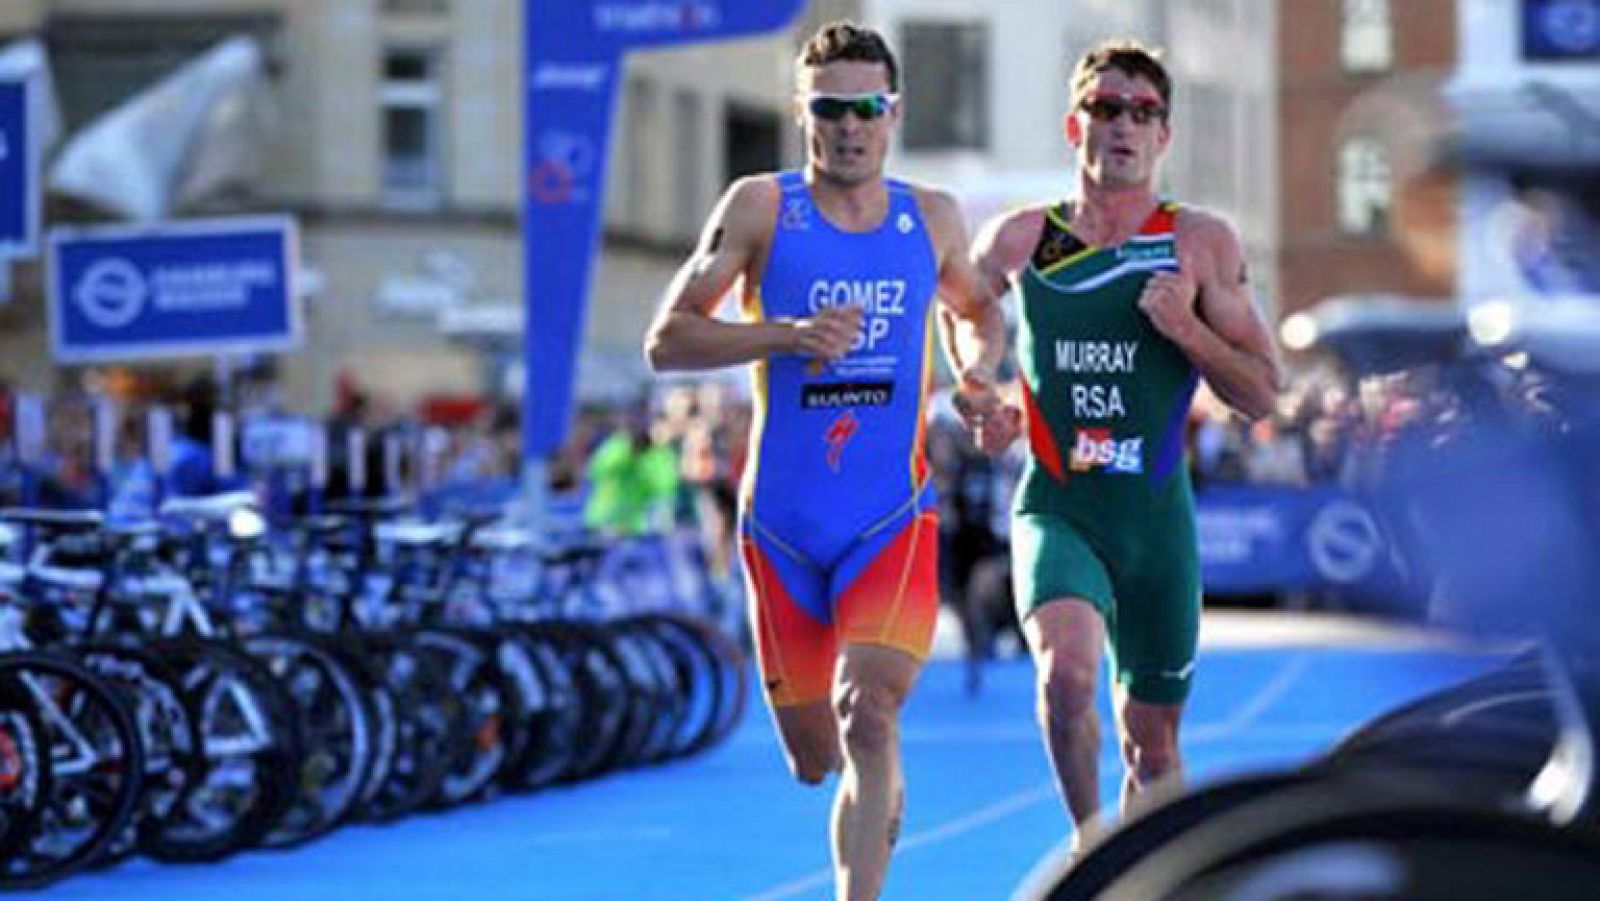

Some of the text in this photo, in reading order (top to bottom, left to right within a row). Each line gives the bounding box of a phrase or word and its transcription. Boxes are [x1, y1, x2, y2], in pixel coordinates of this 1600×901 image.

[808, 280, 906, 314] GOMEZ
[848, 317, 890, 351] SP
[1055, 339, 1138, 373] MURRAY
[1071, 384, 1125, 419] RSA
[1076, 430, 1143, 471] bsg
